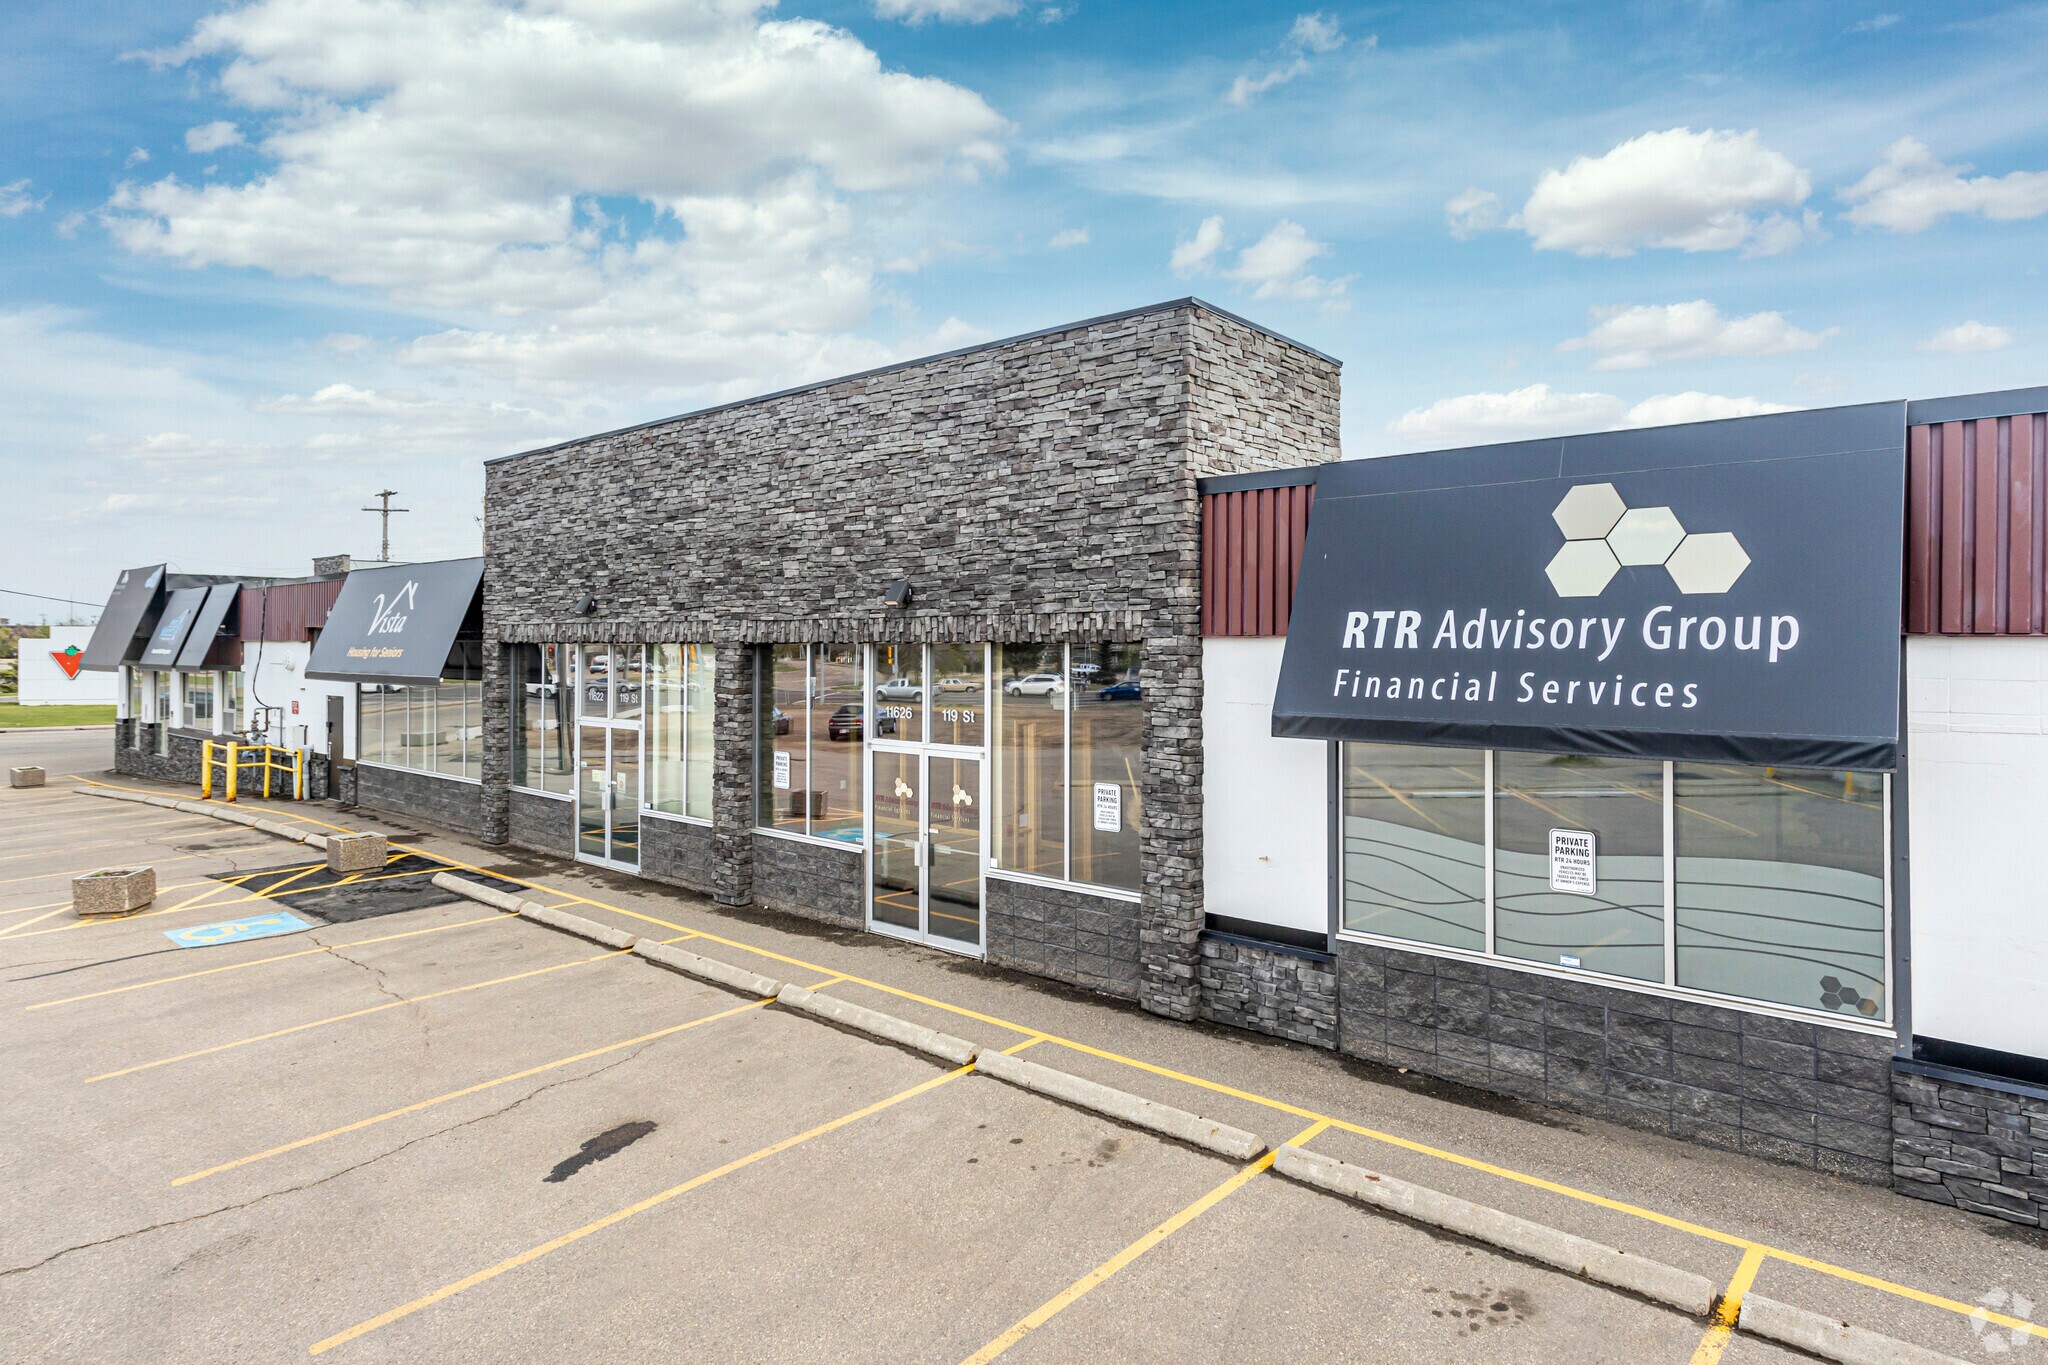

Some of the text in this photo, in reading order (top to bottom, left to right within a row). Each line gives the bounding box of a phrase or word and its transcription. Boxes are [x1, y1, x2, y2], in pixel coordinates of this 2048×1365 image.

[367, 580, 419, 636] Vista
[1341, 605, 1800, 663] RTR Advisory Group
[347, 647, 404, 660] Housing for Seniors
[1333, 669, 1699, 709] Financial Services
[620, 693, 638, 704] 119 St
[885, 705, 913, 719] 11626
[941, 709, 975, 724] 119 St
[1097, 788, 1117, 796] PRIVATE
[1097, 795, 1117, 804] PARKING
[930, 811, 951, 820] Financial
[1556, 836, 1589, 847] PRIVATE
[1555, 846, 1590, 857] PARKING
